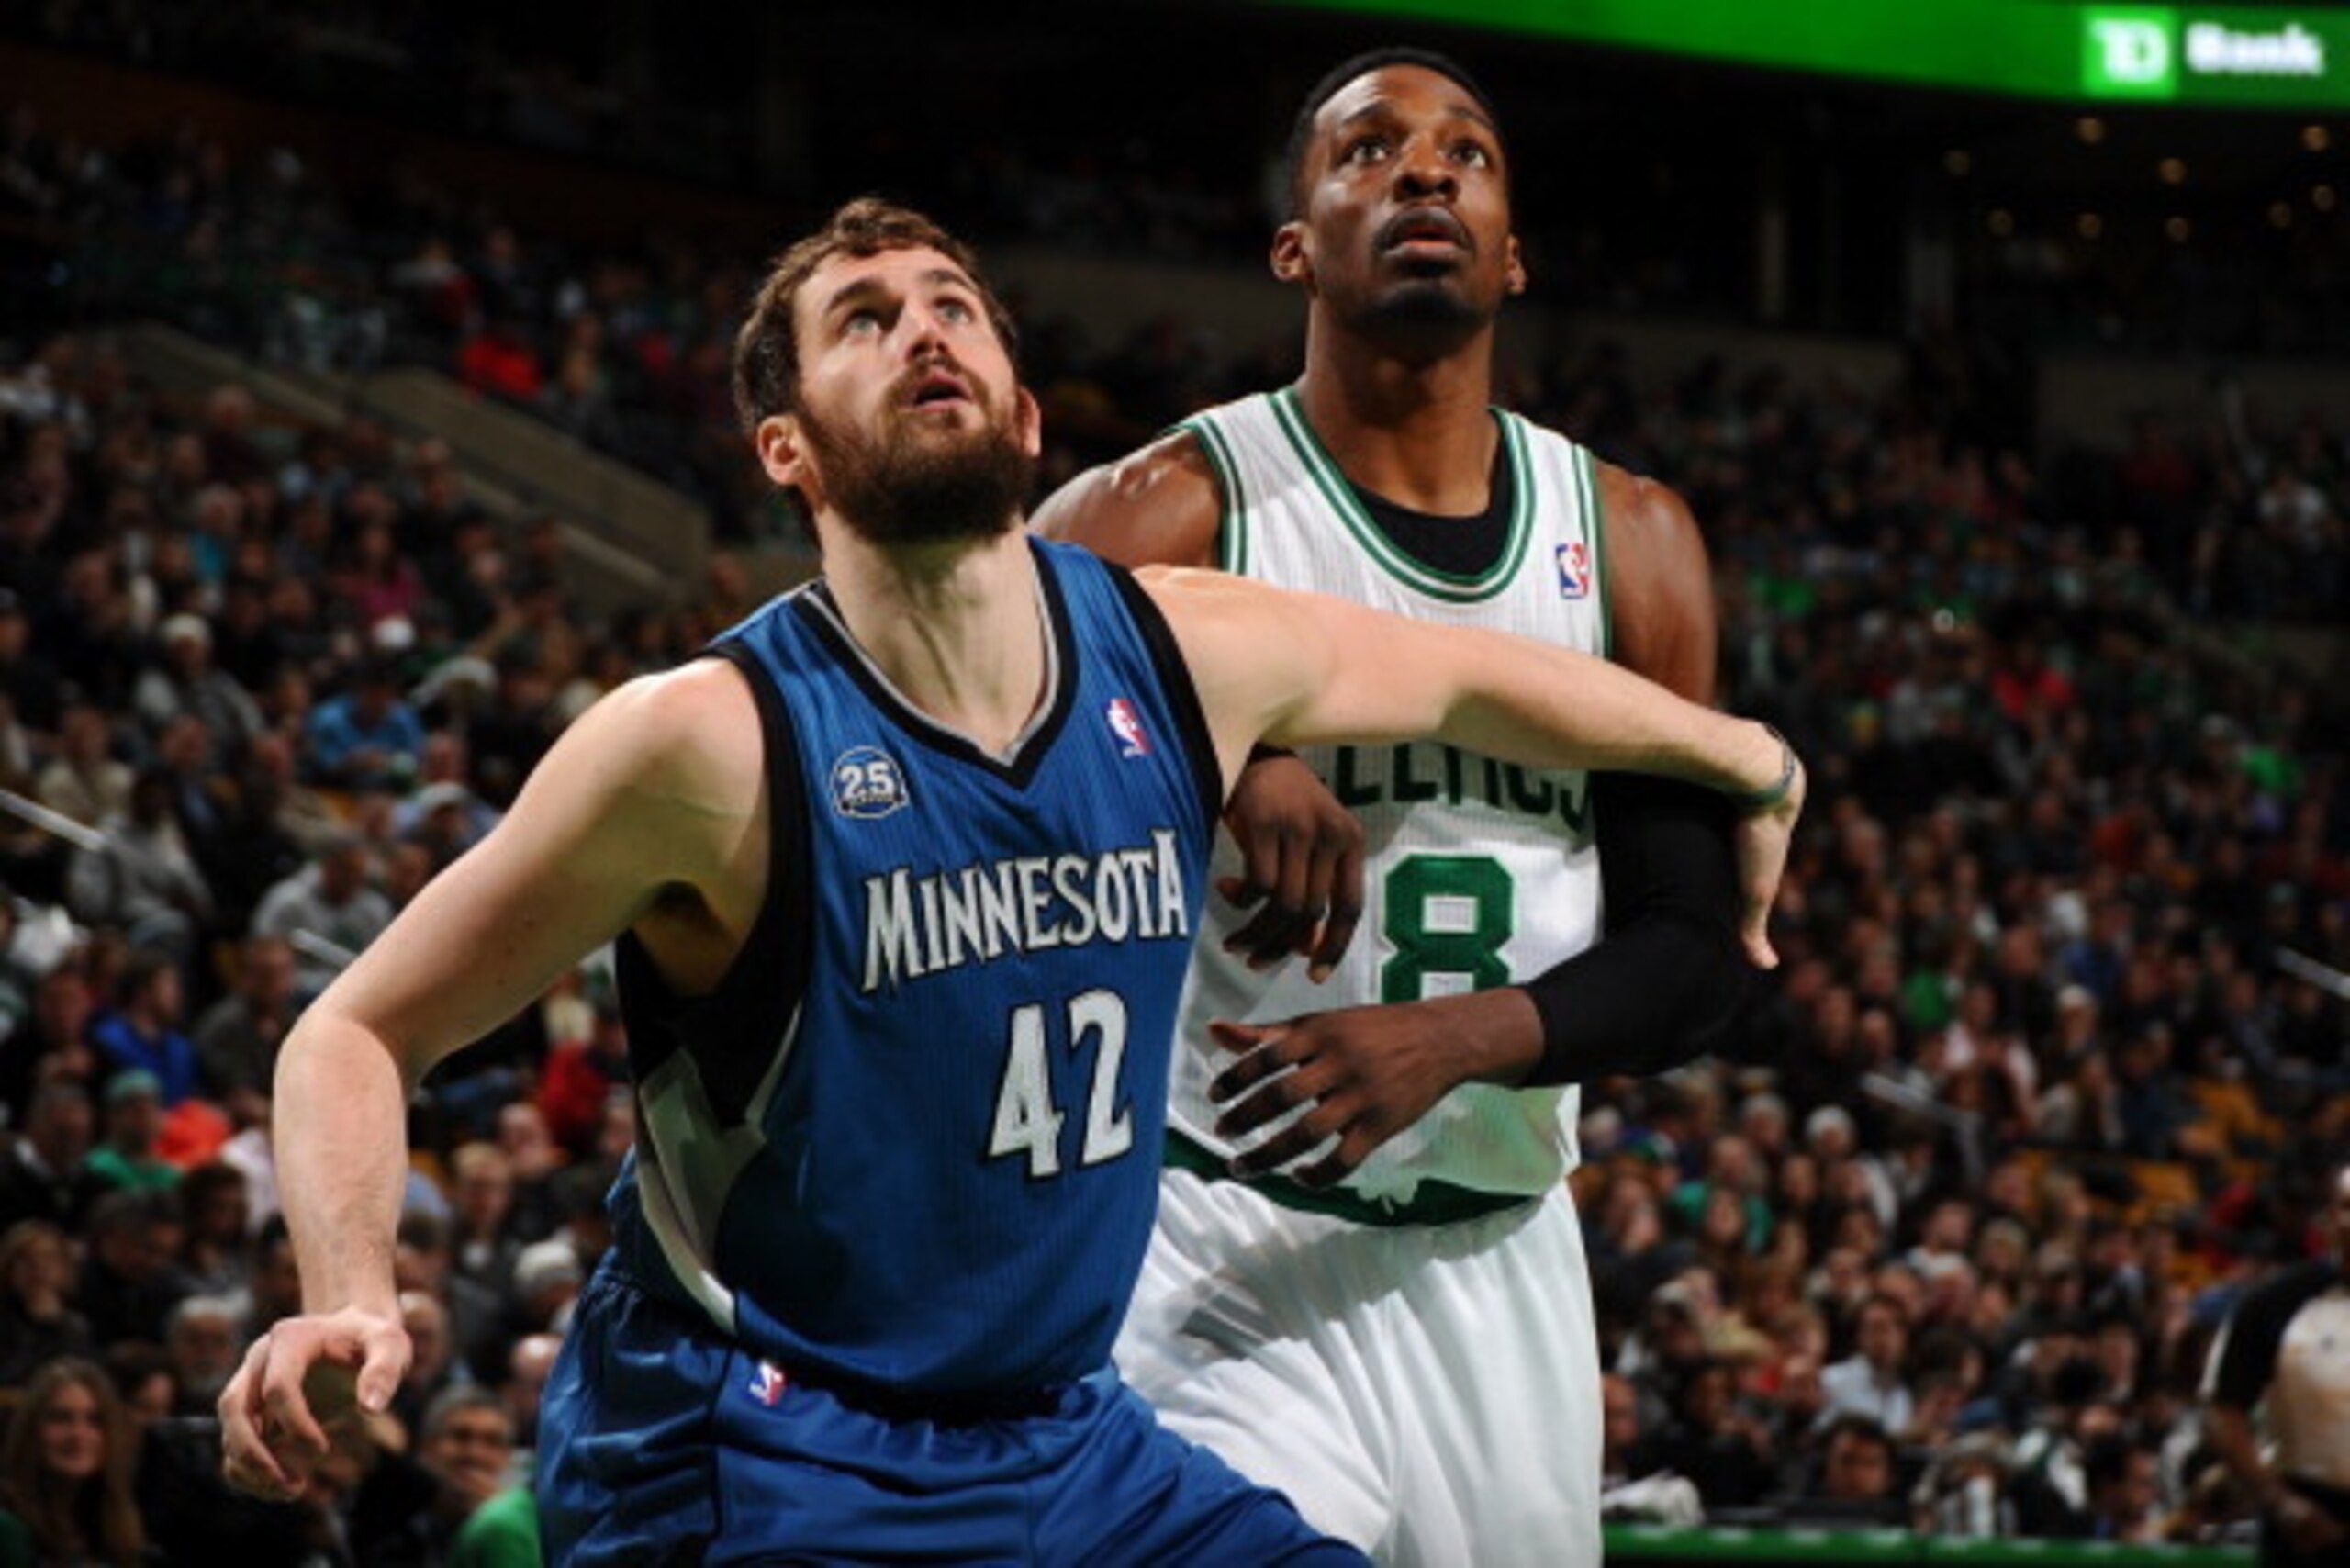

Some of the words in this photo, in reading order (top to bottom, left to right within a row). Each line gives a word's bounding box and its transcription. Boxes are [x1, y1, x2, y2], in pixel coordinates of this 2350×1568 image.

[2089, 18, 2169, 84] TD
[2185, 22, 2325, 76] Bank
[839, 761, 895, 800] 25
[861, 827, 1189, 993] MINNESOTA
[1381, 854, 1514, 1004] 8
[987, 988, 1133, 1178] 42
